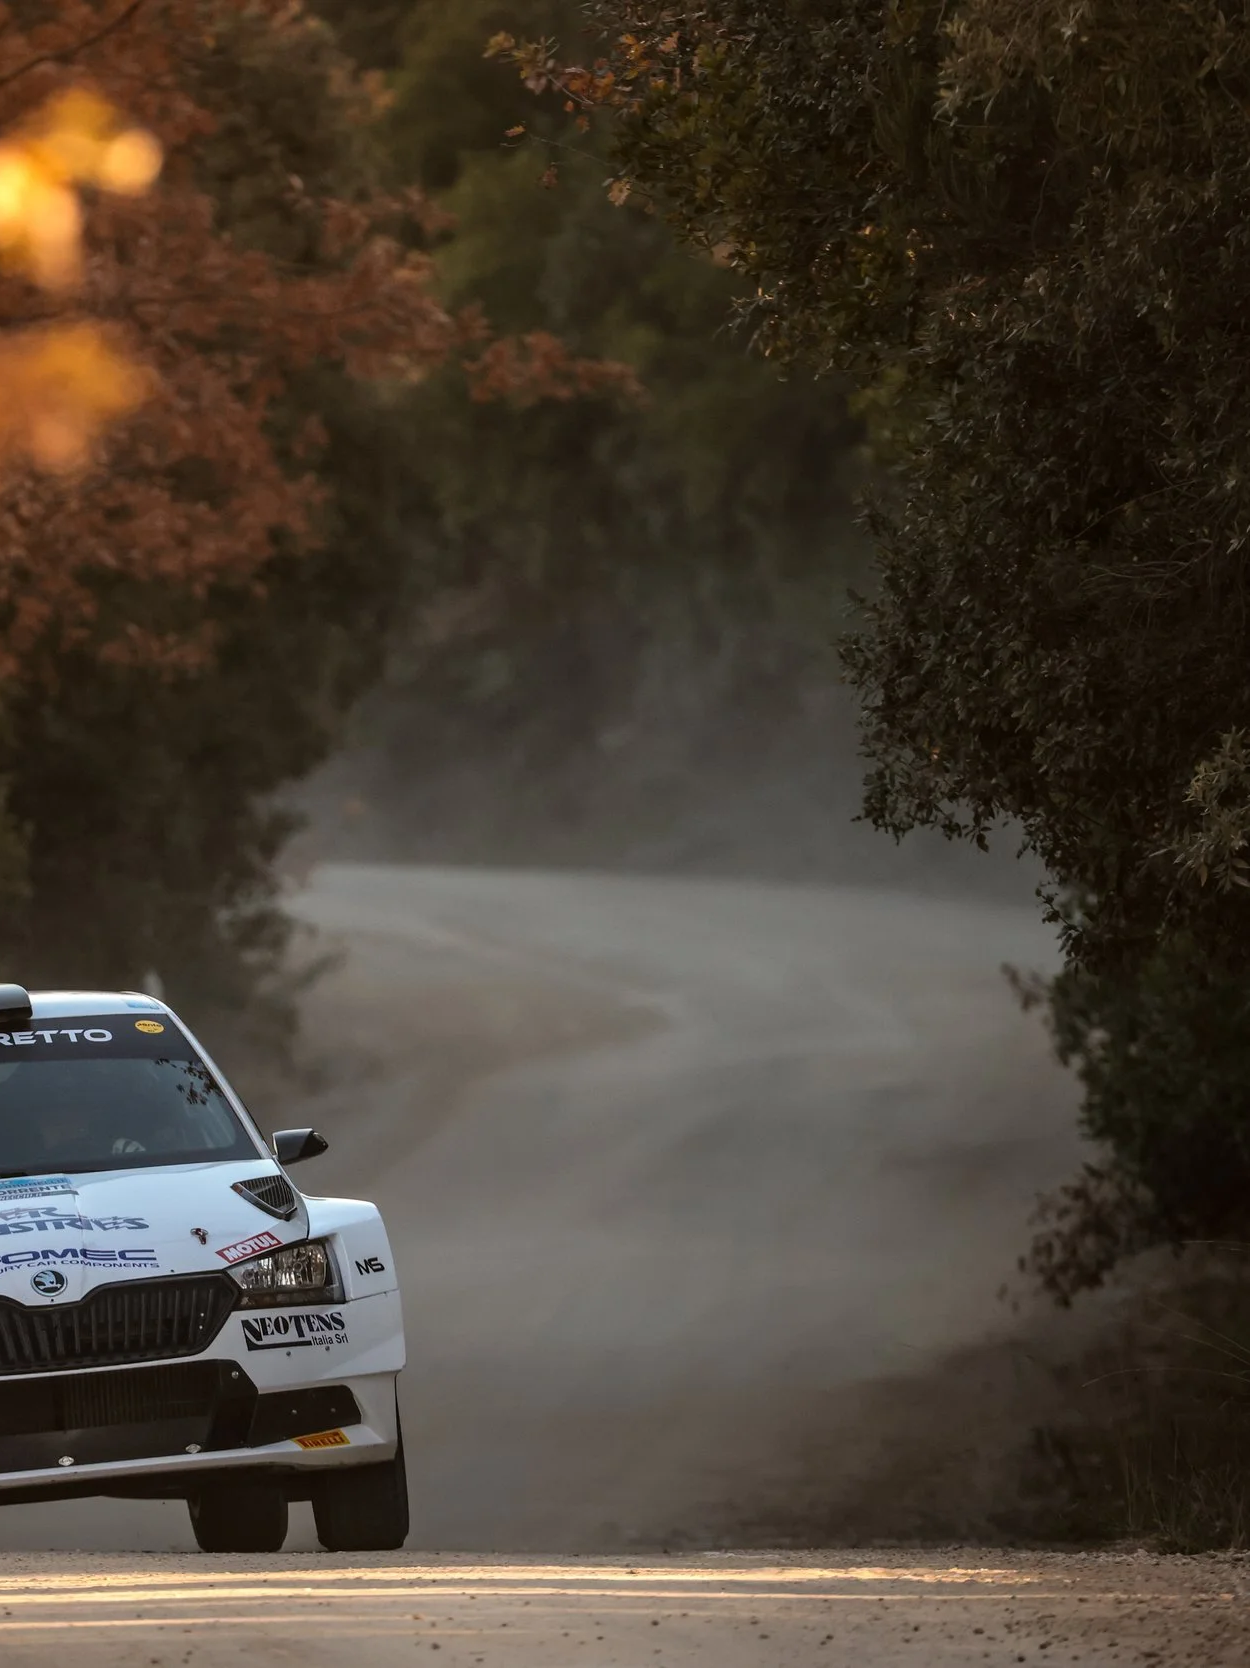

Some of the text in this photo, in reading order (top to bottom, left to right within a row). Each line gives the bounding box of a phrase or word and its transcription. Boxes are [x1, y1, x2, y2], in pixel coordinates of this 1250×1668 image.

[224, 1234, 280, 1261] MOTUL
[27, 1260, 57, 1268] CAR
[60, 1260, 160, 1268] COMPONENTS
[355, 1257, 385, 1275] MS
[241, 1311, 346, 1343] NEOTENS
[311, 1333, 349, 1346] Italia Srl
